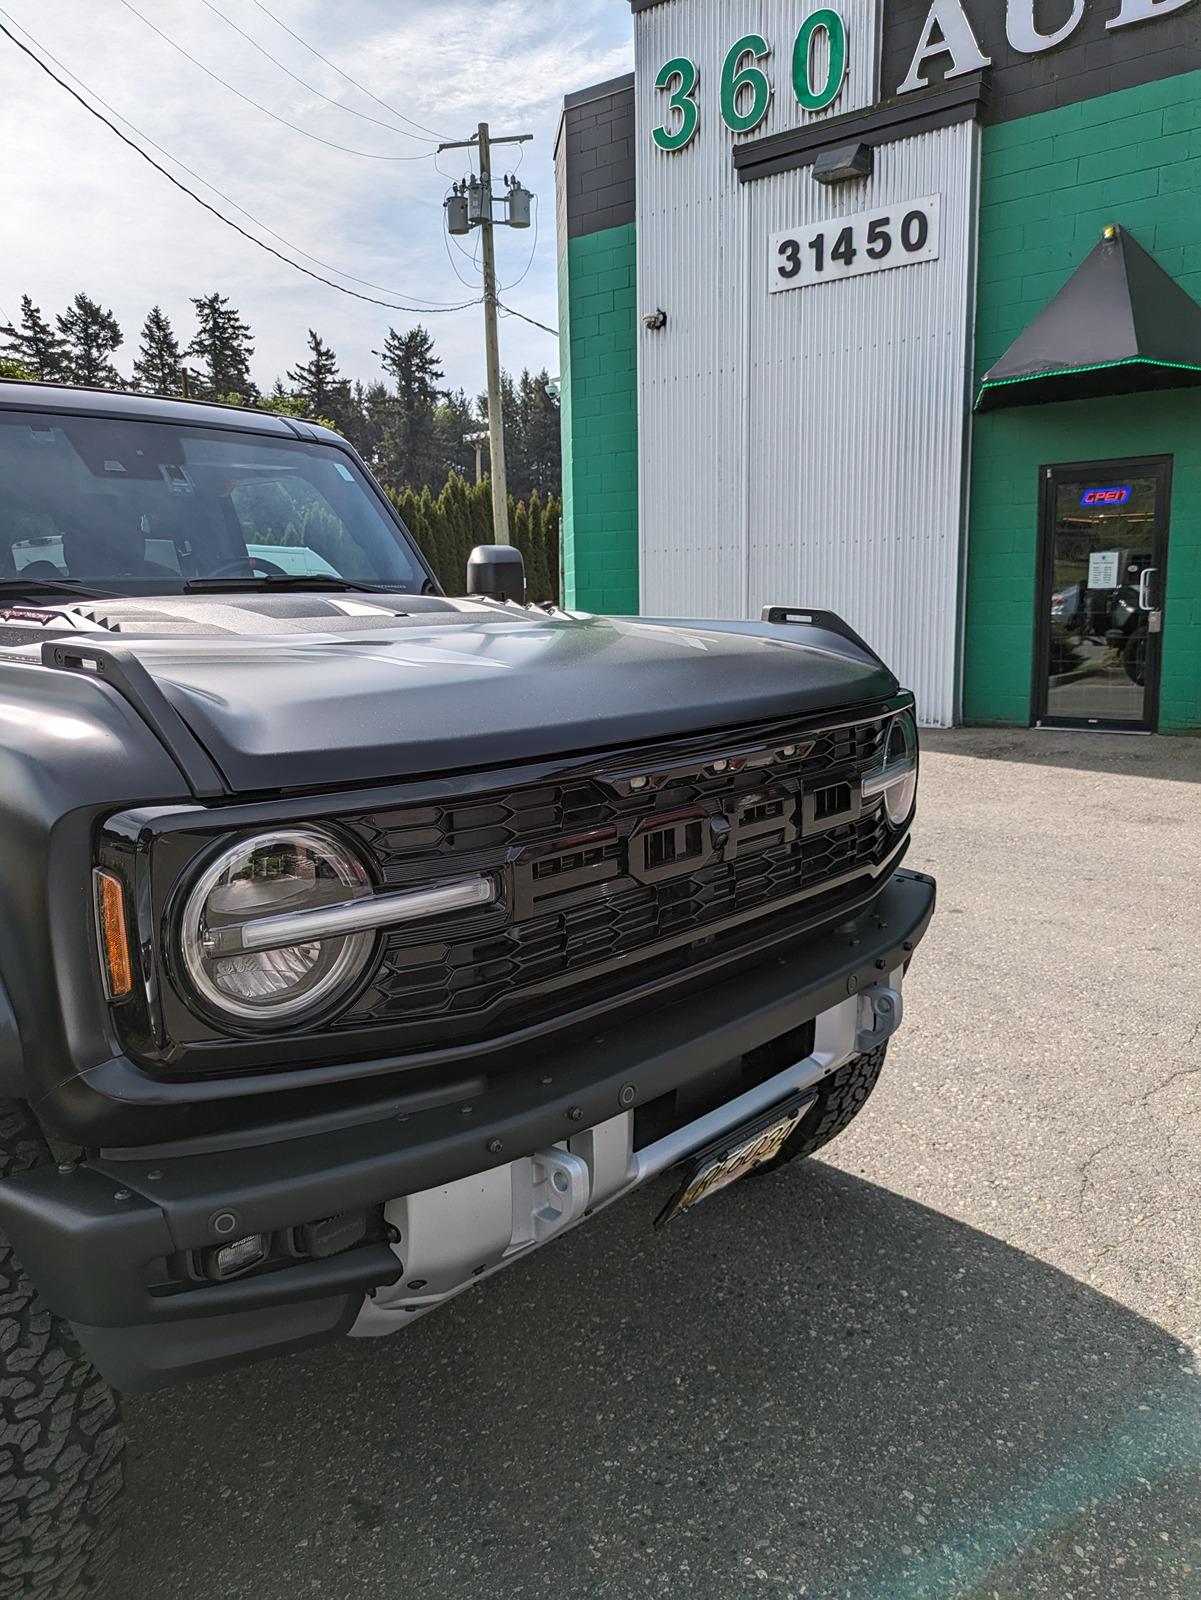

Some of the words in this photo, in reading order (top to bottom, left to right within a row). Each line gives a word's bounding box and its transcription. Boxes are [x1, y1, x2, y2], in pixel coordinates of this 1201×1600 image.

[651, 7, 848, 152] 360
[776, 209, 929, 279] 31450
[1084, 489, 1127, 503] OPEN
[511, 764, 864, 922] FORD
